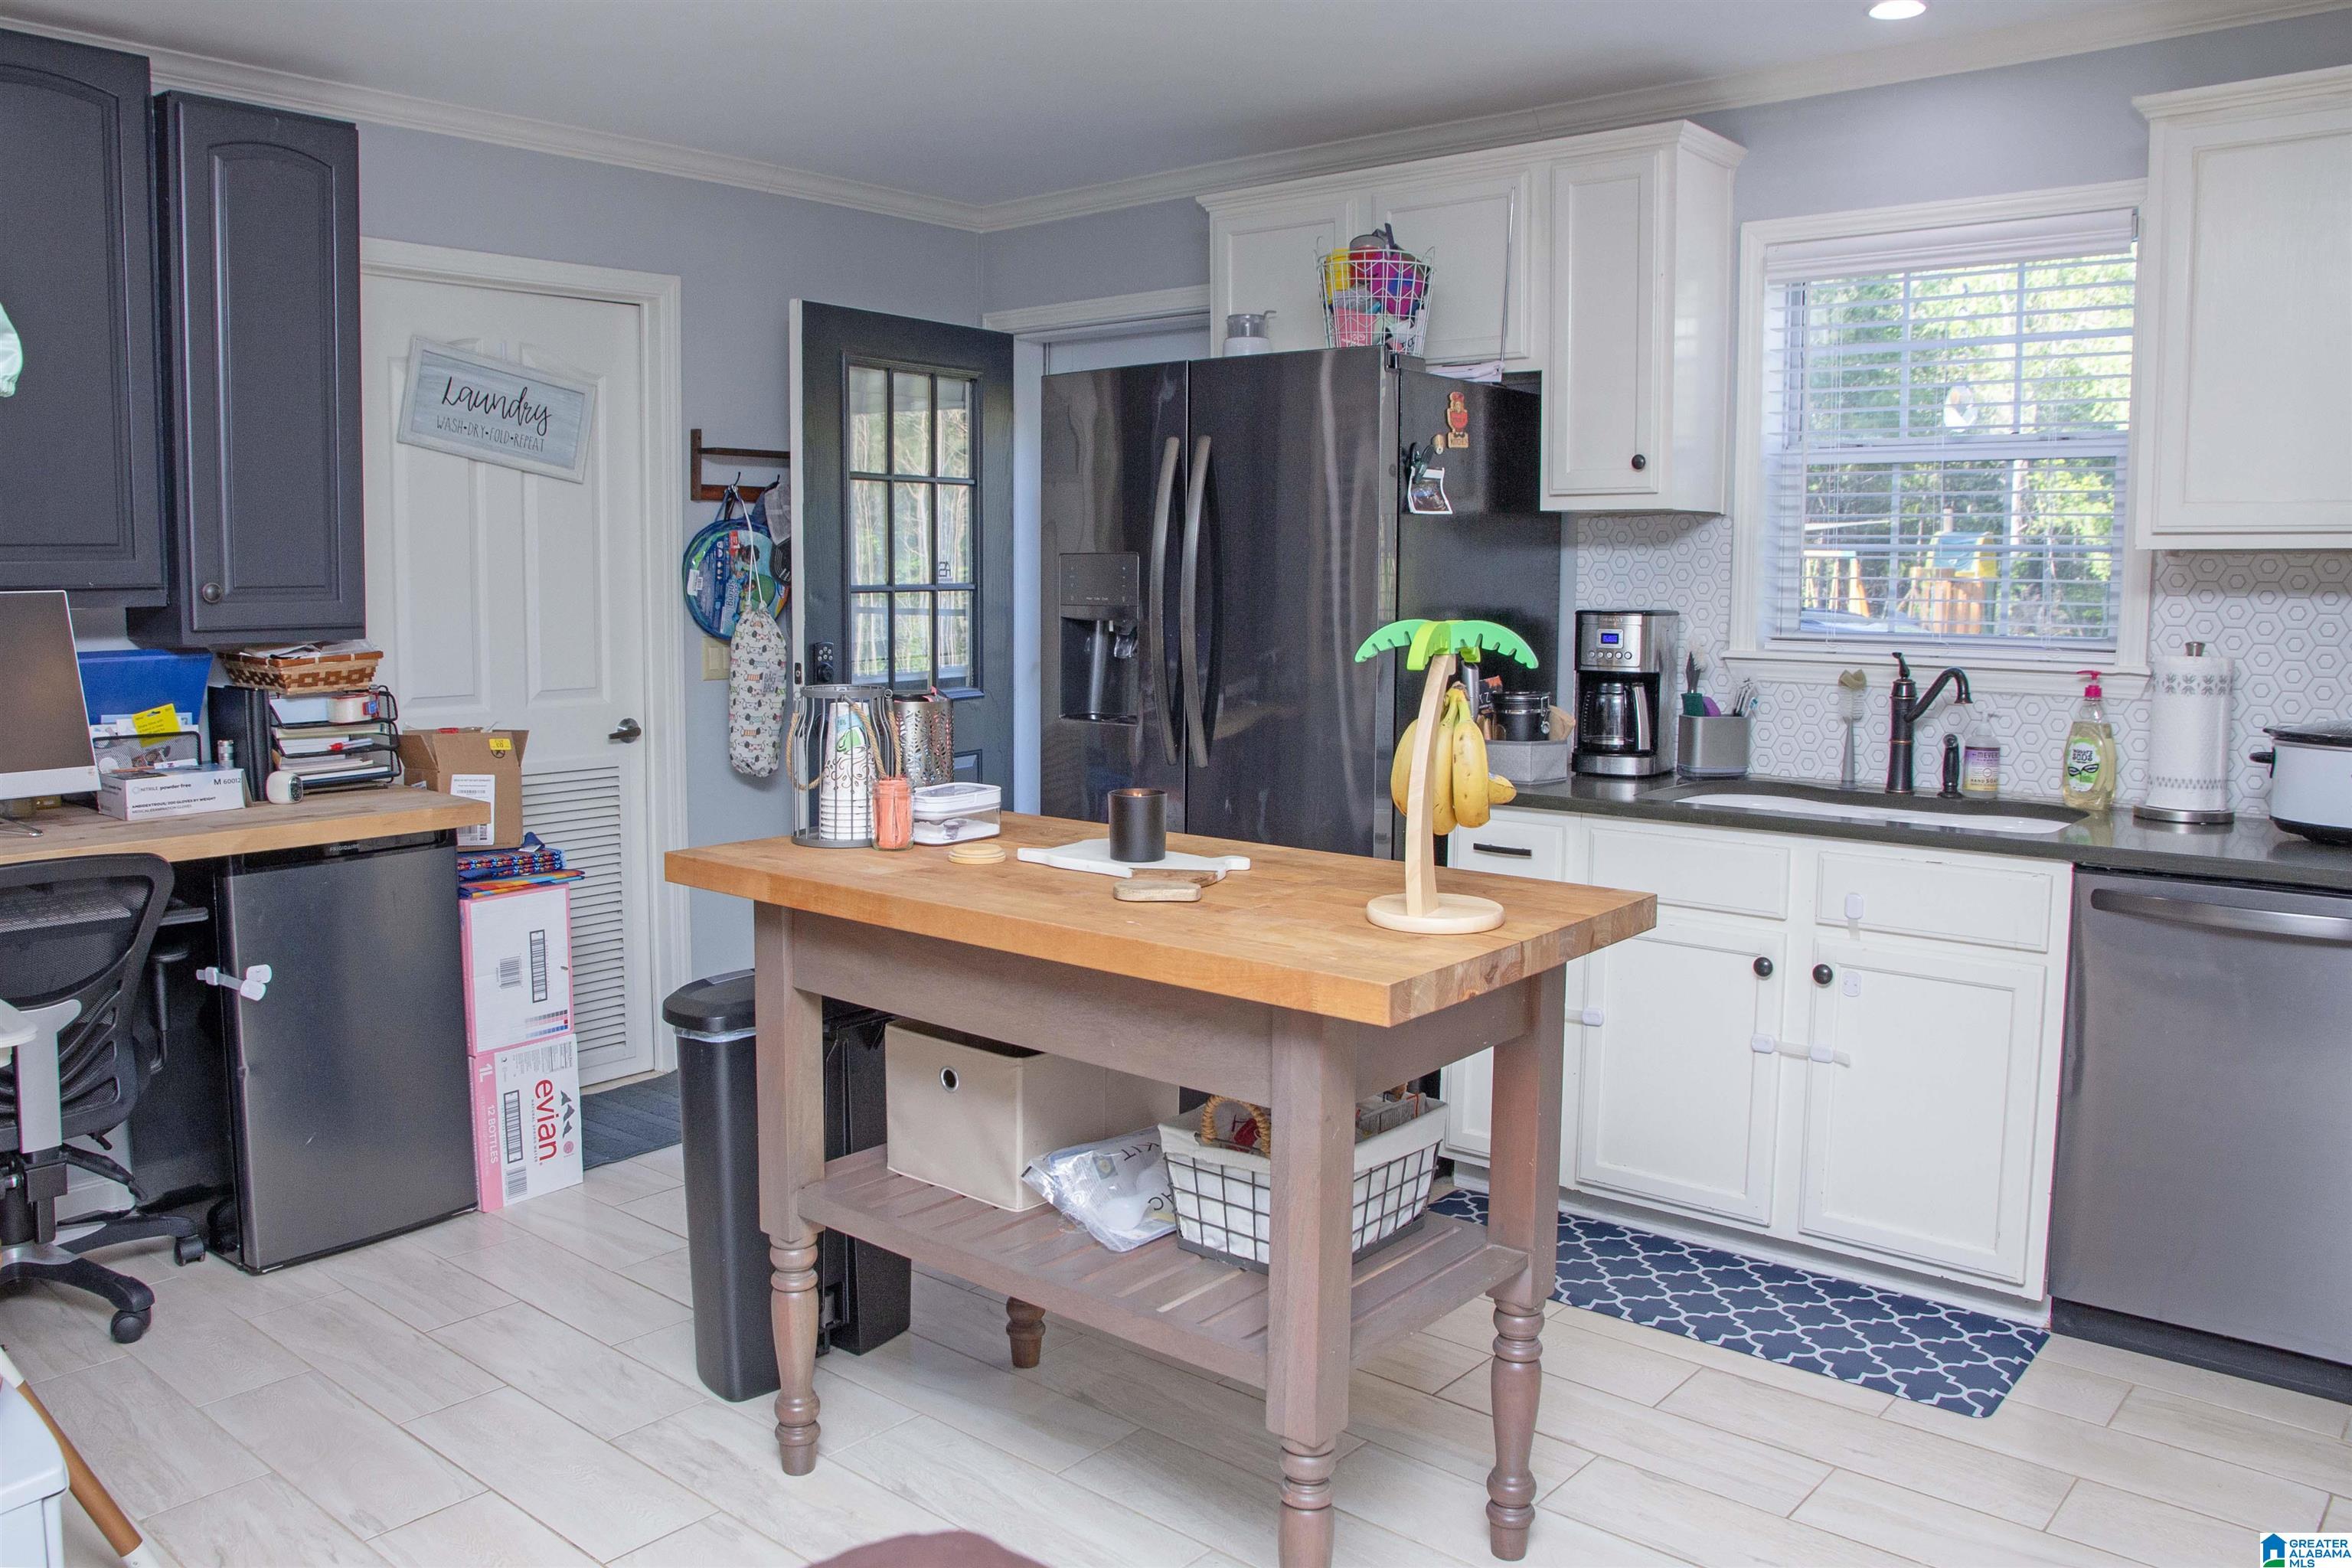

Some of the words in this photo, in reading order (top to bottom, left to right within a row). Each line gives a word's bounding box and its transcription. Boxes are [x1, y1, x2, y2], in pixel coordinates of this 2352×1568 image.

[442, 376, 552, 436] Laundry
[436, 415, 464, 434] WASH
[467, 422, 485, 439] DRY
[489, 427, 510, 445] FOLD
[514, 433, 544, 453] REPEAT
[479, 1063, 493, 1083] 1L
[488, 1105, 495, 1116] 12
[535, 1080, 559, 1161] evian
[488, 1118, 498, 1164] BOTTLES
